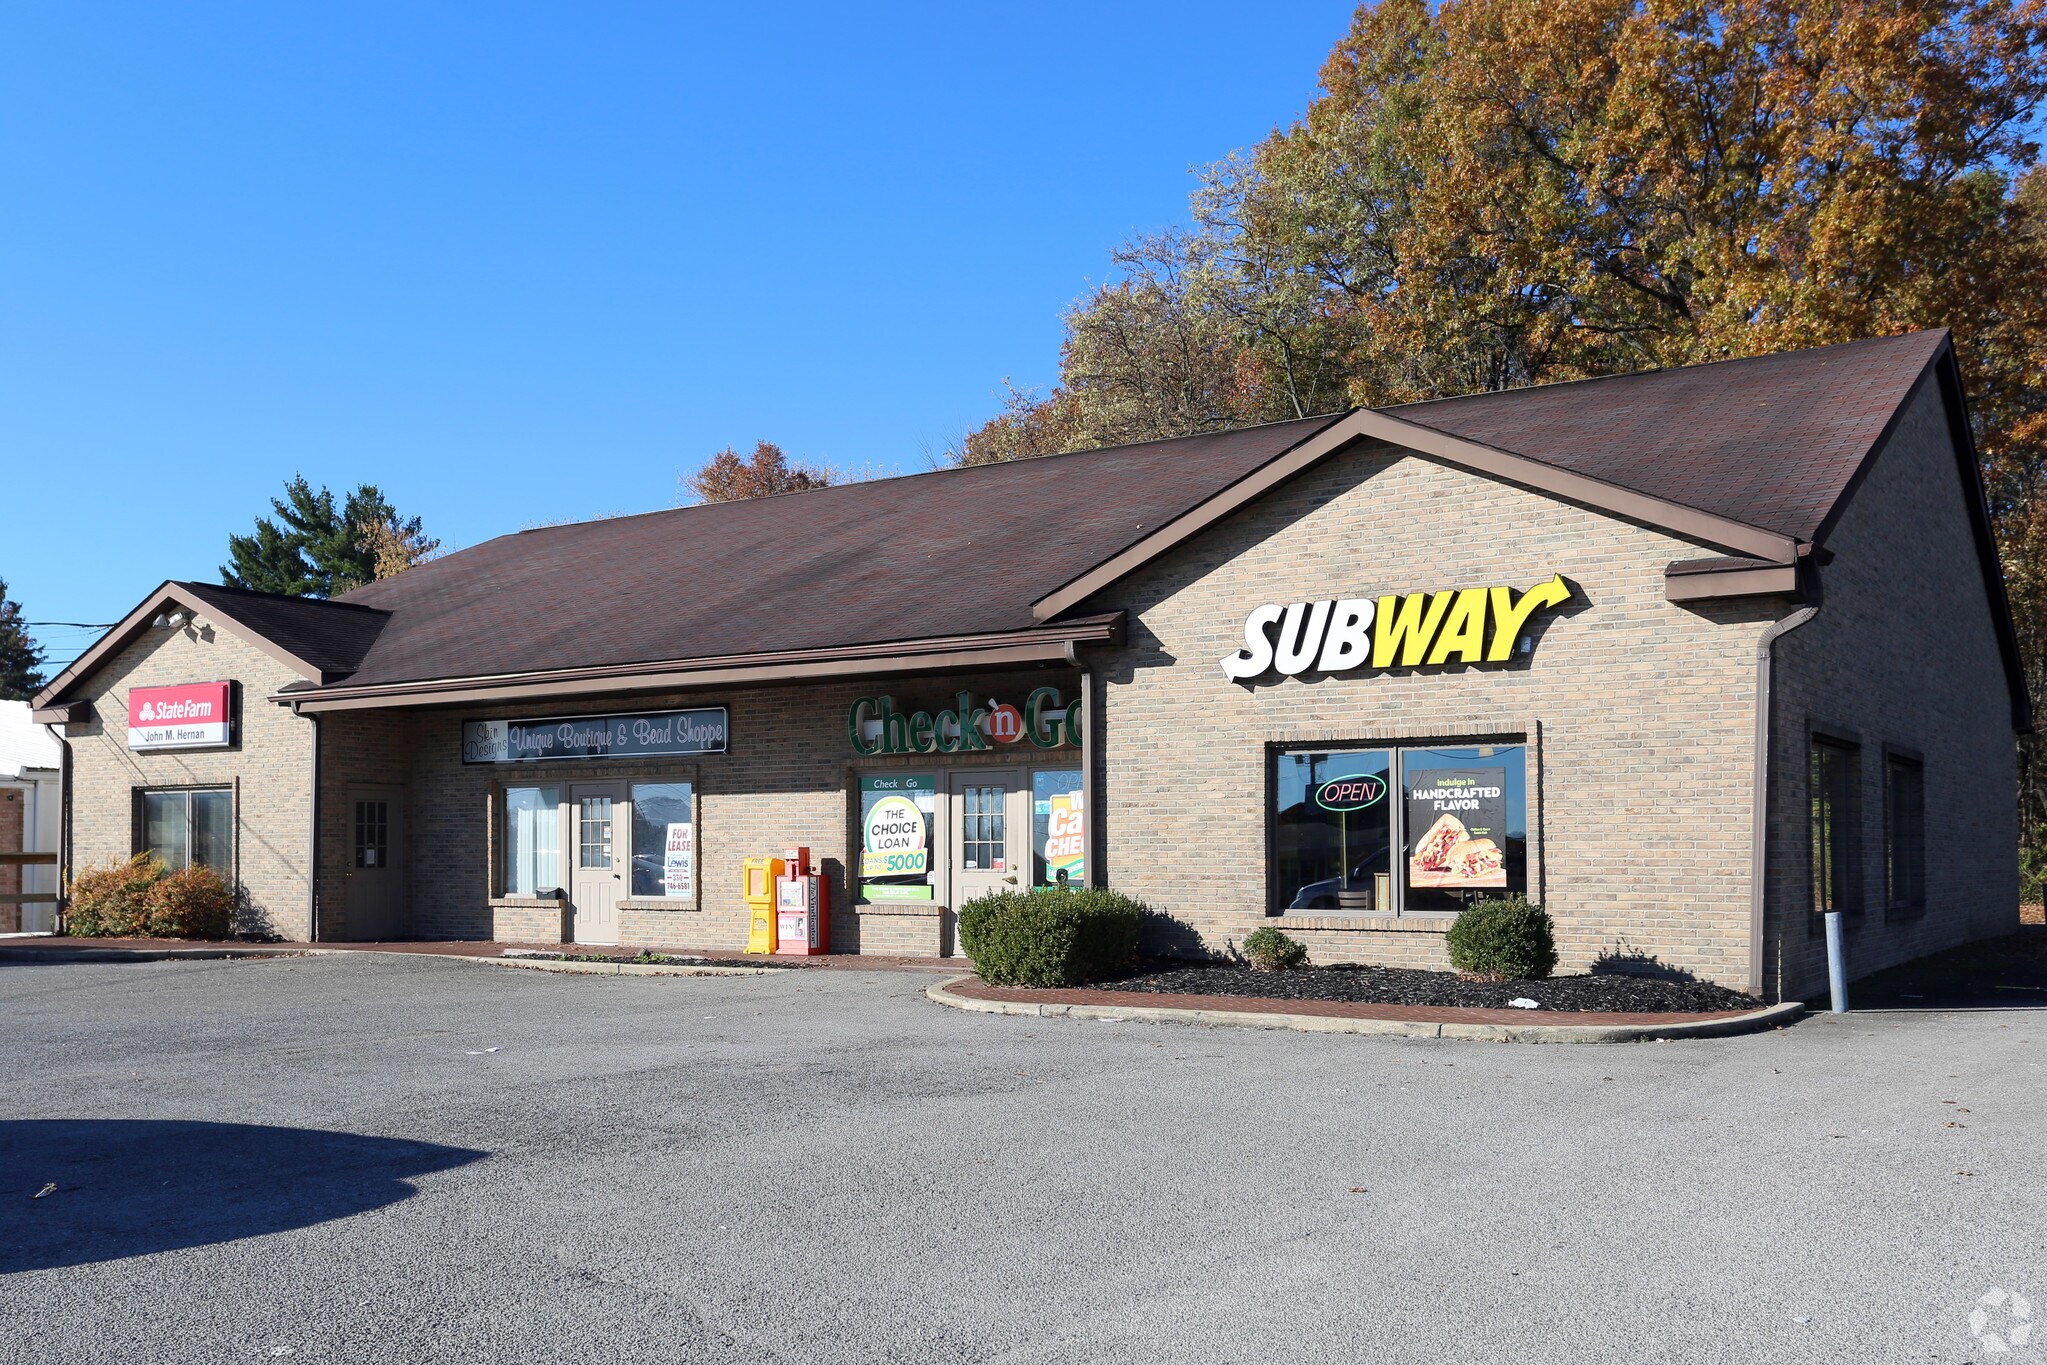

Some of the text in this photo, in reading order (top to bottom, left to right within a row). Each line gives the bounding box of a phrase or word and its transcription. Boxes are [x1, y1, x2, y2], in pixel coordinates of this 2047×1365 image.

[1219, 573, 1571, 684] SUBWAY
[848, 690, 990, 755] Check
[146, 730, 205, 742] John M. Hernan
[476, 723, 499, 744] Skin
[509, 716, 723, 756] Unique Boutique & Bead Shoppe
[465, 740, 508, 760] Designs
[873, 778, 918, 789] Check Go
[1437, 778, 1467, 788] Indulge
[1324, 782, 1377, 802] OPEN
[1413, 787, 1501, 800] HANDCRAFTED
[1434, 800, 1480, 811] FLAVOR
[885, 808, 905, 820] THE
[672, 829, 688, 839] FOR
[871, 821, 918, 836] CHOICE
[667, 840, 691, 851] LEASE
[878, 837, 910, 849] LOAN
[667, 856, 689, 868] Lewis
